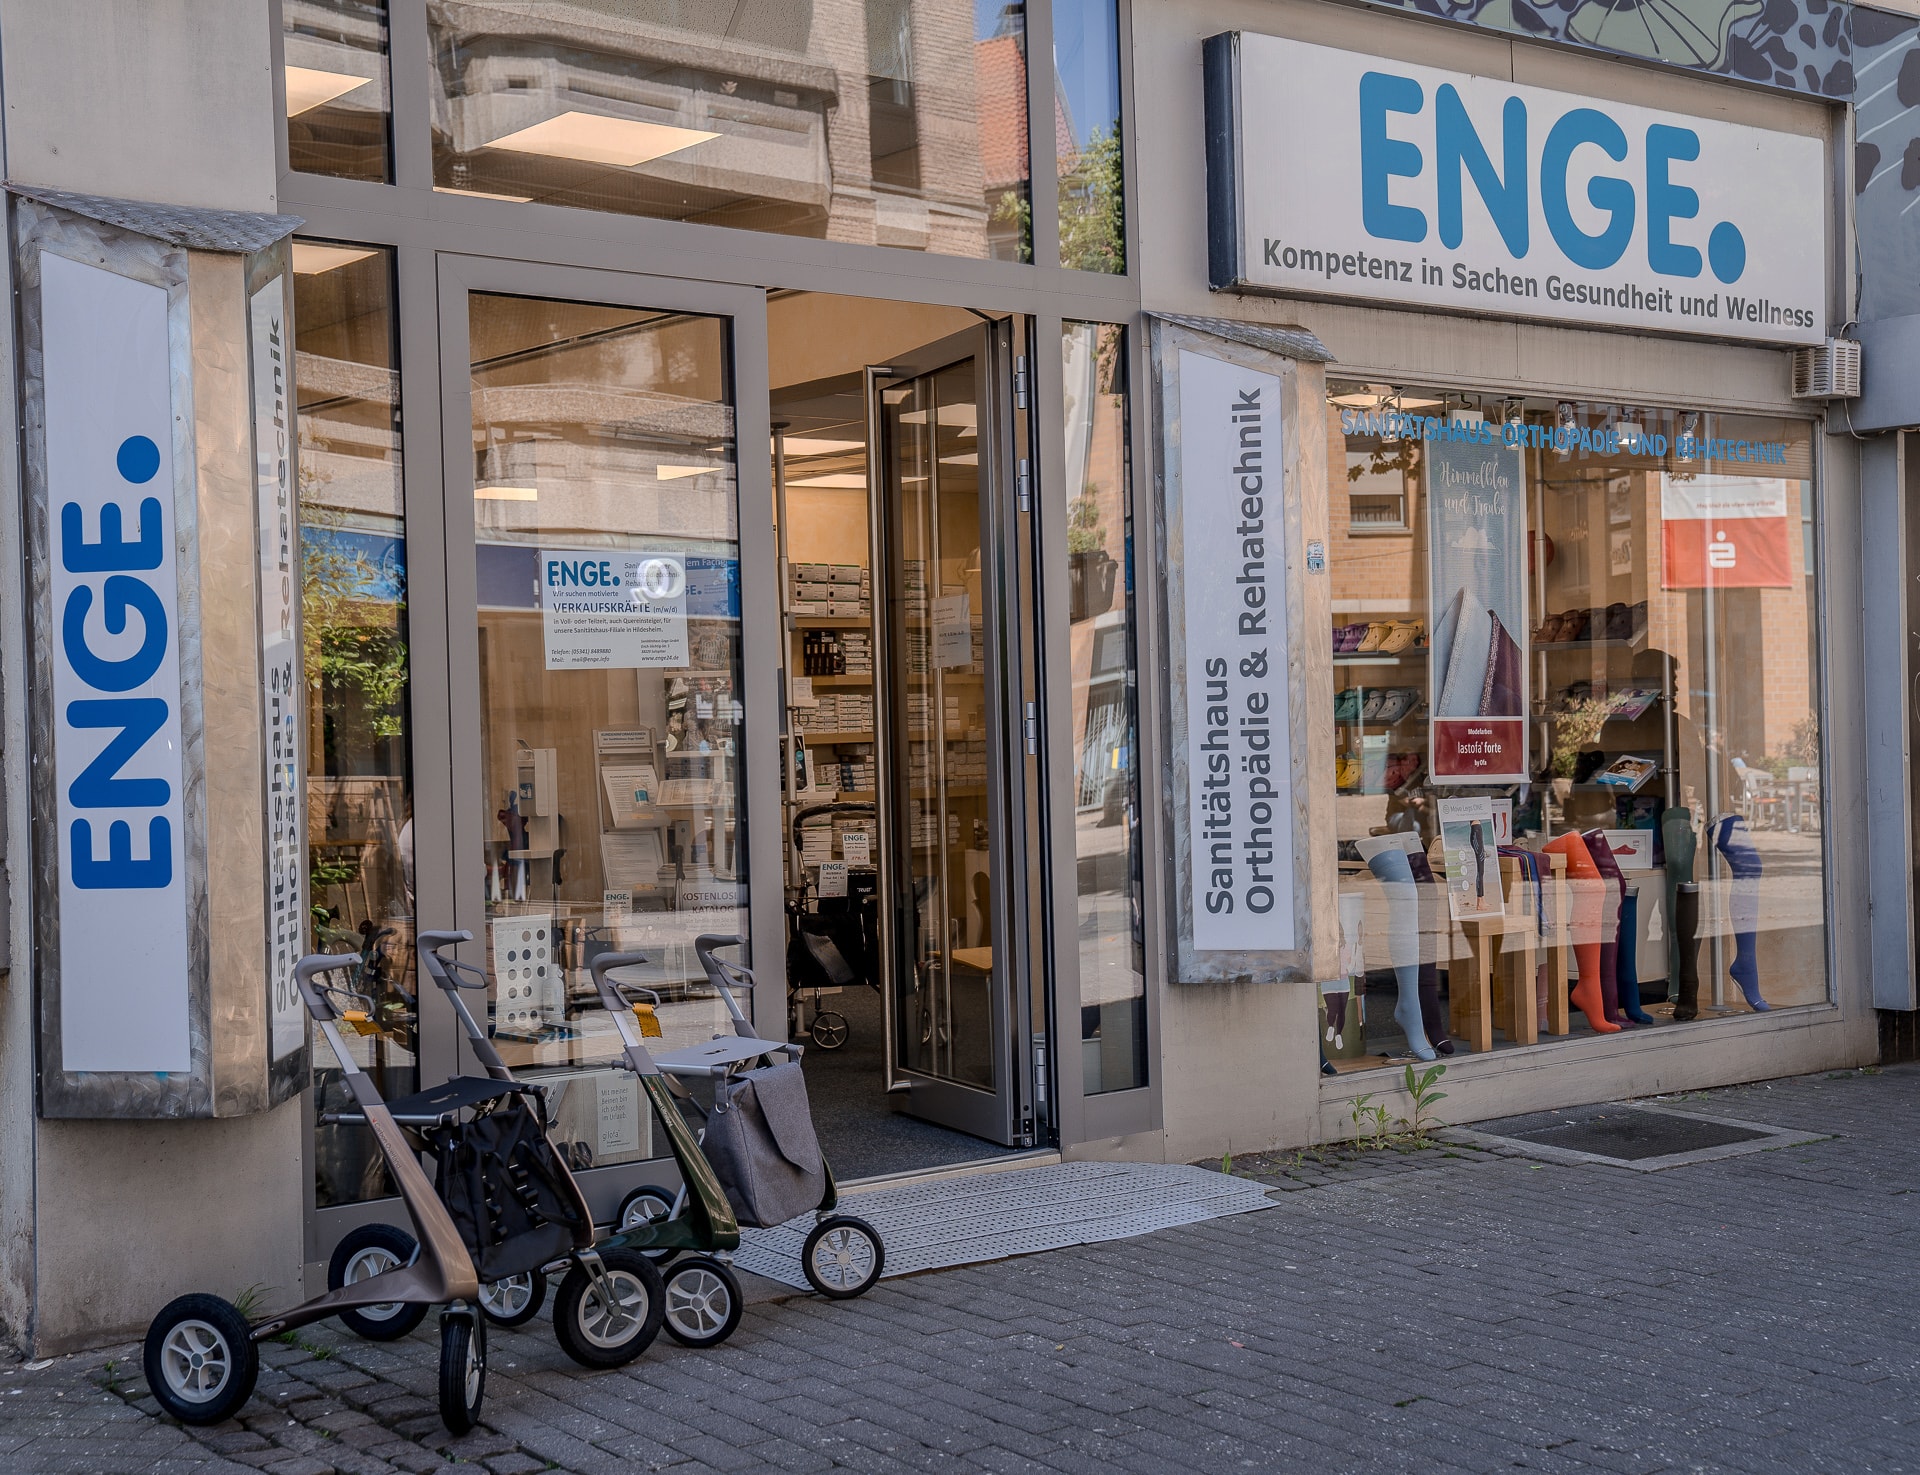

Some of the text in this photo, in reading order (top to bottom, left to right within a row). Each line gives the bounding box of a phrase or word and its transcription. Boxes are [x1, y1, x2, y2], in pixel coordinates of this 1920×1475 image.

[1359, 70, 1746, 284] ENGE.
[1263, 237, 1814, 329] Kompetenz in Sachen Gesundheit und Wellness
[1340, 409, 1493, 445] SANITÄTSHAUS
[1501, 422, 1620, 454] ORTHOPÄDIE
[1628, 432, 1668, 457] UND
[1675, 435, 1787, 465] REHATECHNIK
[1444, 491, 1506, 516] und Traube
[547, 560, 621, 587] ENGE.
[553, 600, 678, 614] VERKAUFSKRÄFTE (m/w/d)
[61, 435, 173, 889] ENGE.
[269, 316, 300, 1006] Orthopädie & Rehatechnik
[1231, 387, 1279, 915] Orthopädie & Rehatechnik
[1201, 656, 1234, 916] Sanitätshaus
[1484, 741, 1502, 754] forte
[270, 667, 287, 1014] Sanitätshaus
